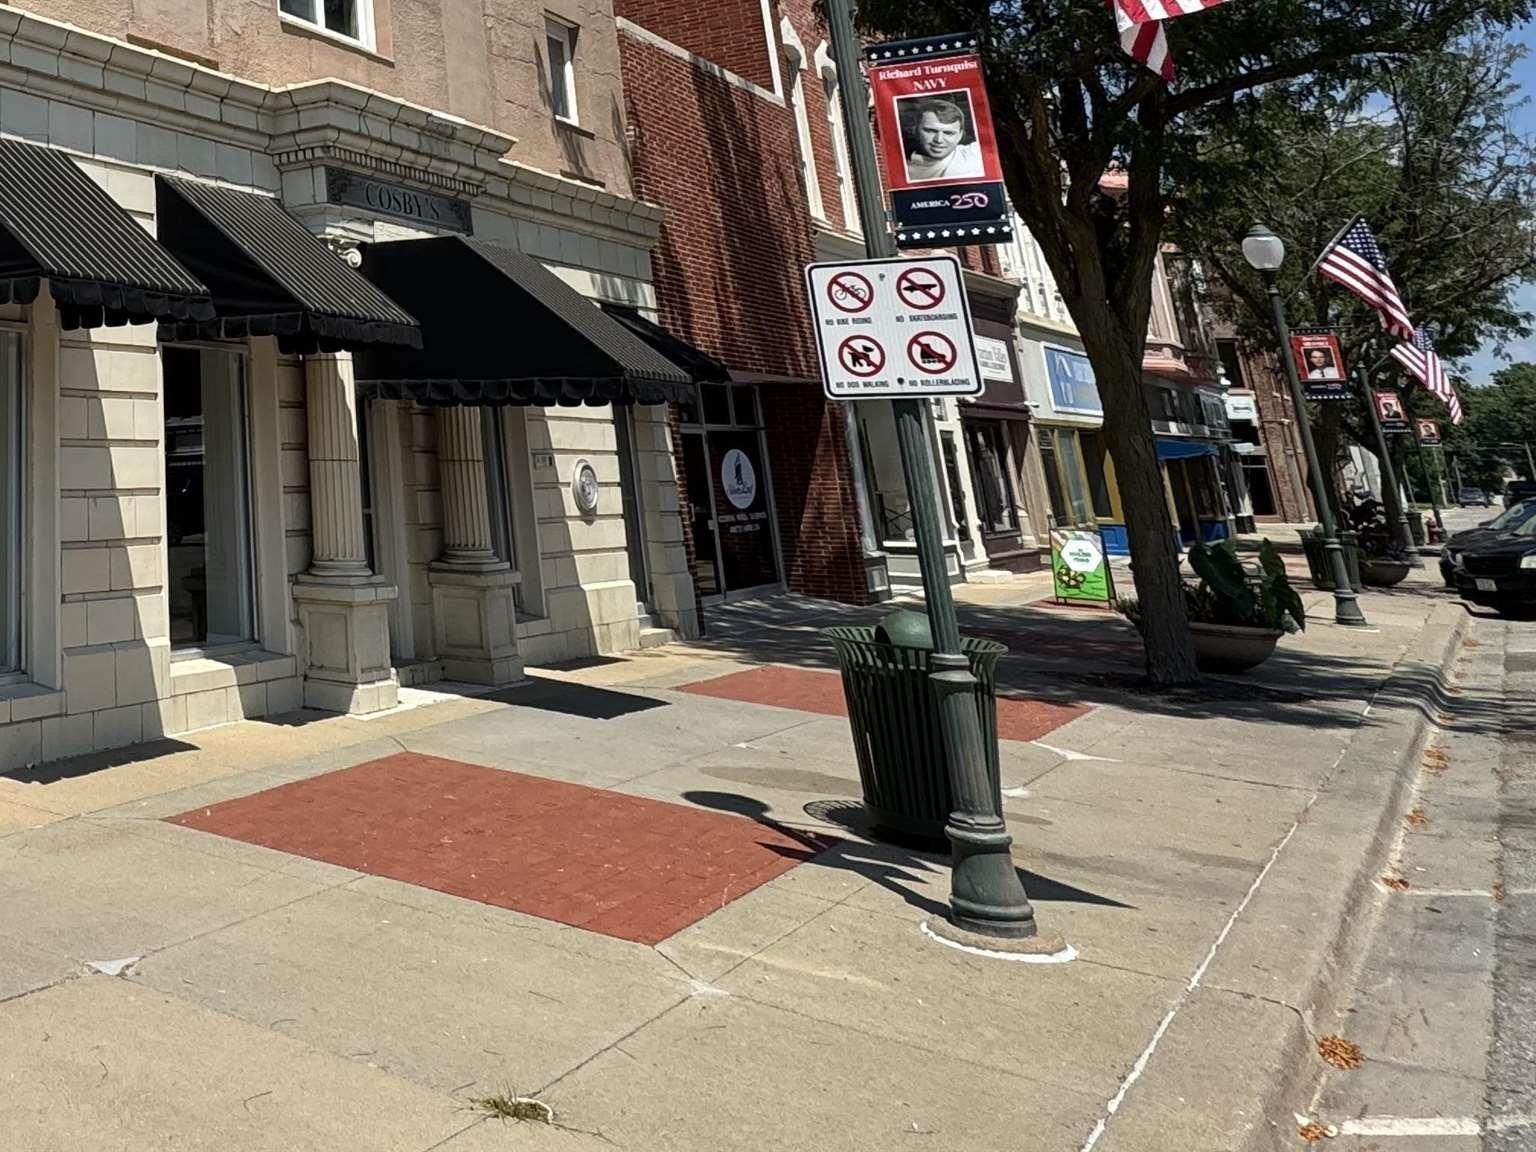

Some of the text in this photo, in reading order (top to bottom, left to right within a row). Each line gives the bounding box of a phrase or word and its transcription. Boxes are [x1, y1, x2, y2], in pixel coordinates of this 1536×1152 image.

[879, 67, 922, 80] Richard
[913, 78, 946, 91] NAVY
[365, 181, 440, 221] COSBY'S
[910, 192, 989, 210] AMERICA 250
[909, 313, 958, 322] SKATEBOARDING
[920, 378, 971, 386] ROLLERBLADING
